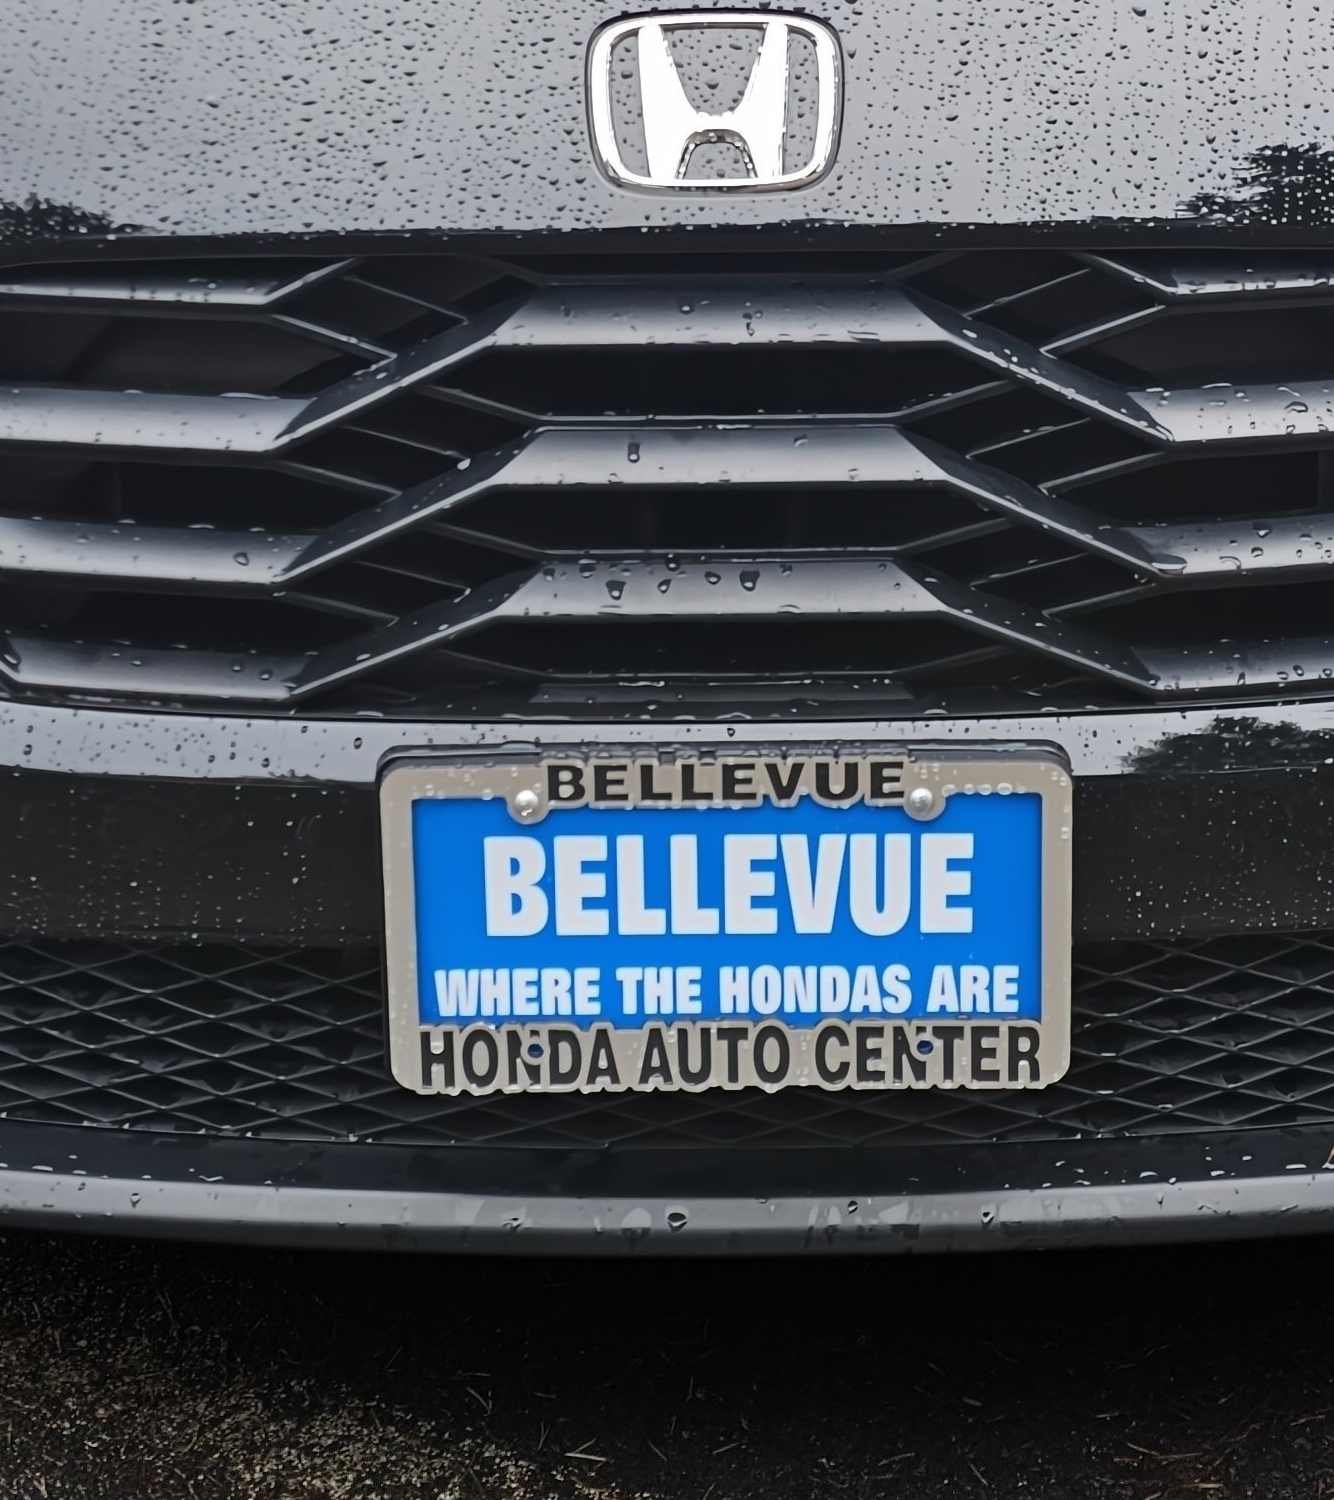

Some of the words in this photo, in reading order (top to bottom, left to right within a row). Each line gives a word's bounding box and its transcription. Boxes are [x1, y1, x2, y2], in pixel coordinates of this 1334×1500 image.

[547, 761, 905, 801] BELLEVUE
[484, 833, 974, 937] BELLEVUE
[434, 968, 600, 1017] WHERE
[616, 966, 702, 1015] THE
[719, 964, 912, 1014] HONDAS
[927, 965, 1020, 1013] ARE
[419, 1031, 621, 1088] HONDA
[638, 1028, 791, 1086] AUTO
[814, 1026, 1042, 1084] CENTER
